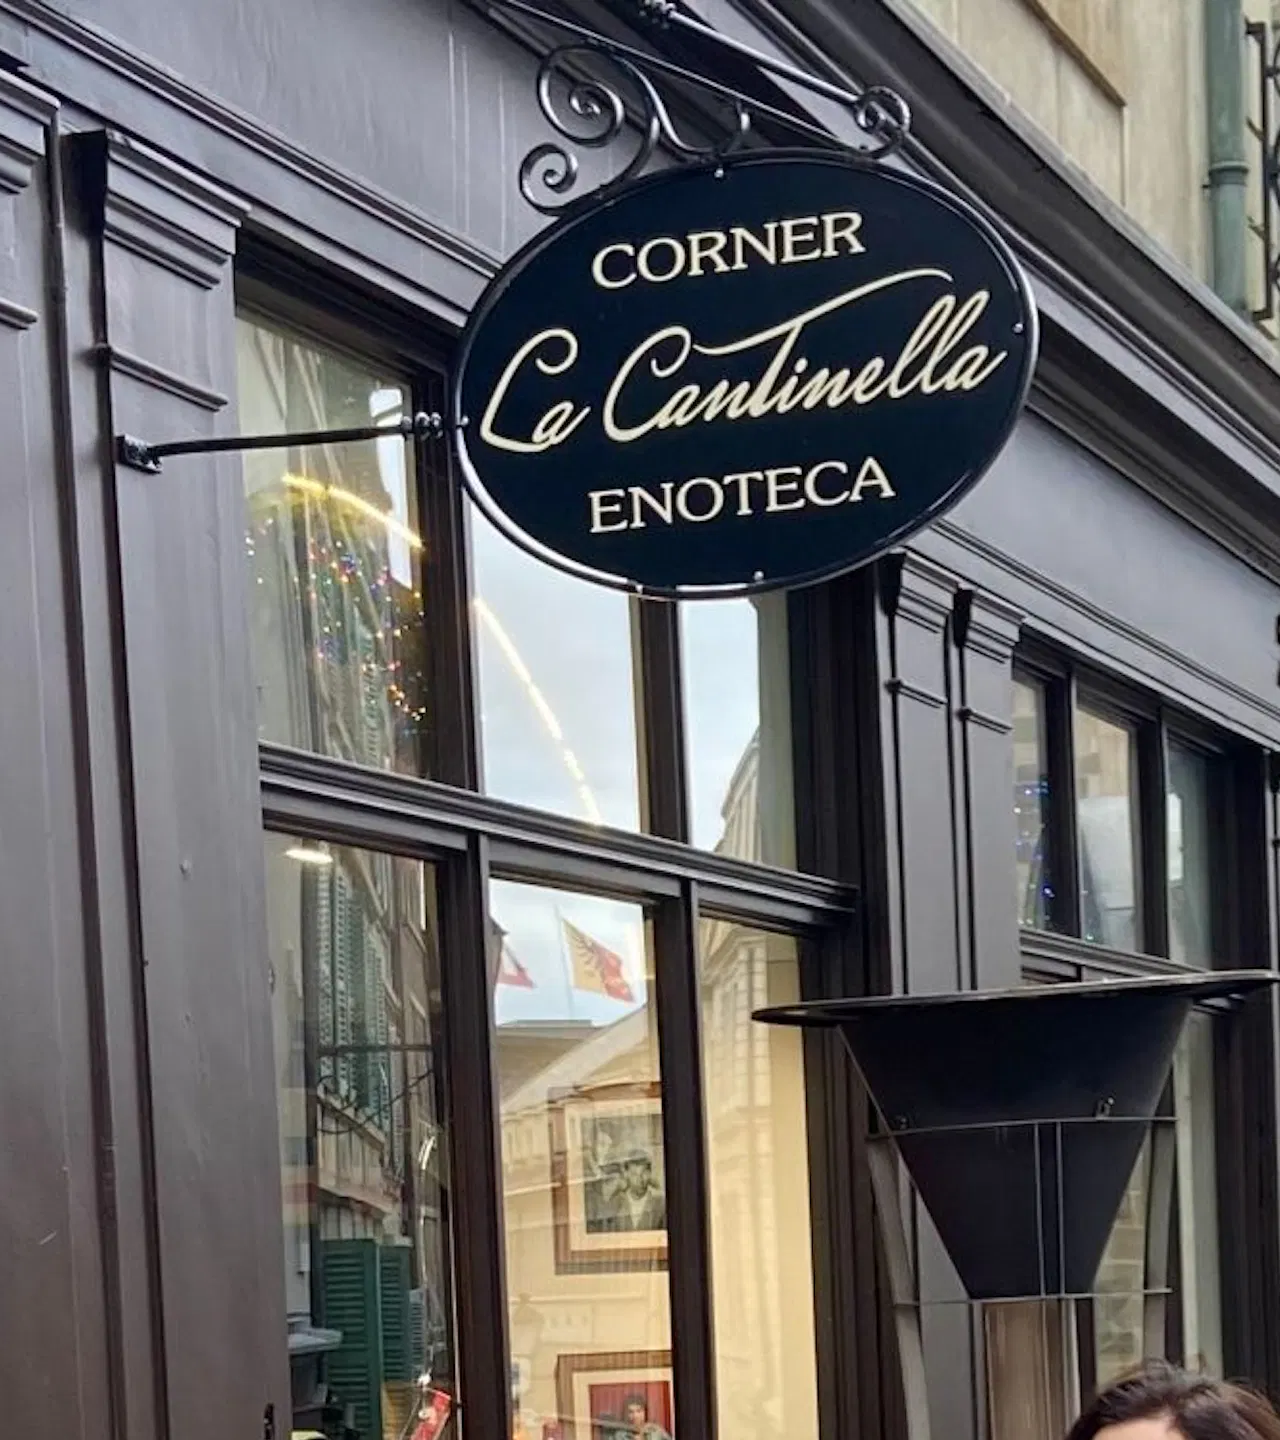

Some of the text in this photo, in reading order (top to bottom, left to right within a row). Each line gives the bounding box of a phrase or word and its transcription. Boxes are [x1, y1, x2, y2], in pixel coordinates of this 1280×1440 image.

[593, 211, 866, 289] CORNER
[480, 269, 1008, 453] La Cantinella
[588, 455, 897, 534] ENOTECA
